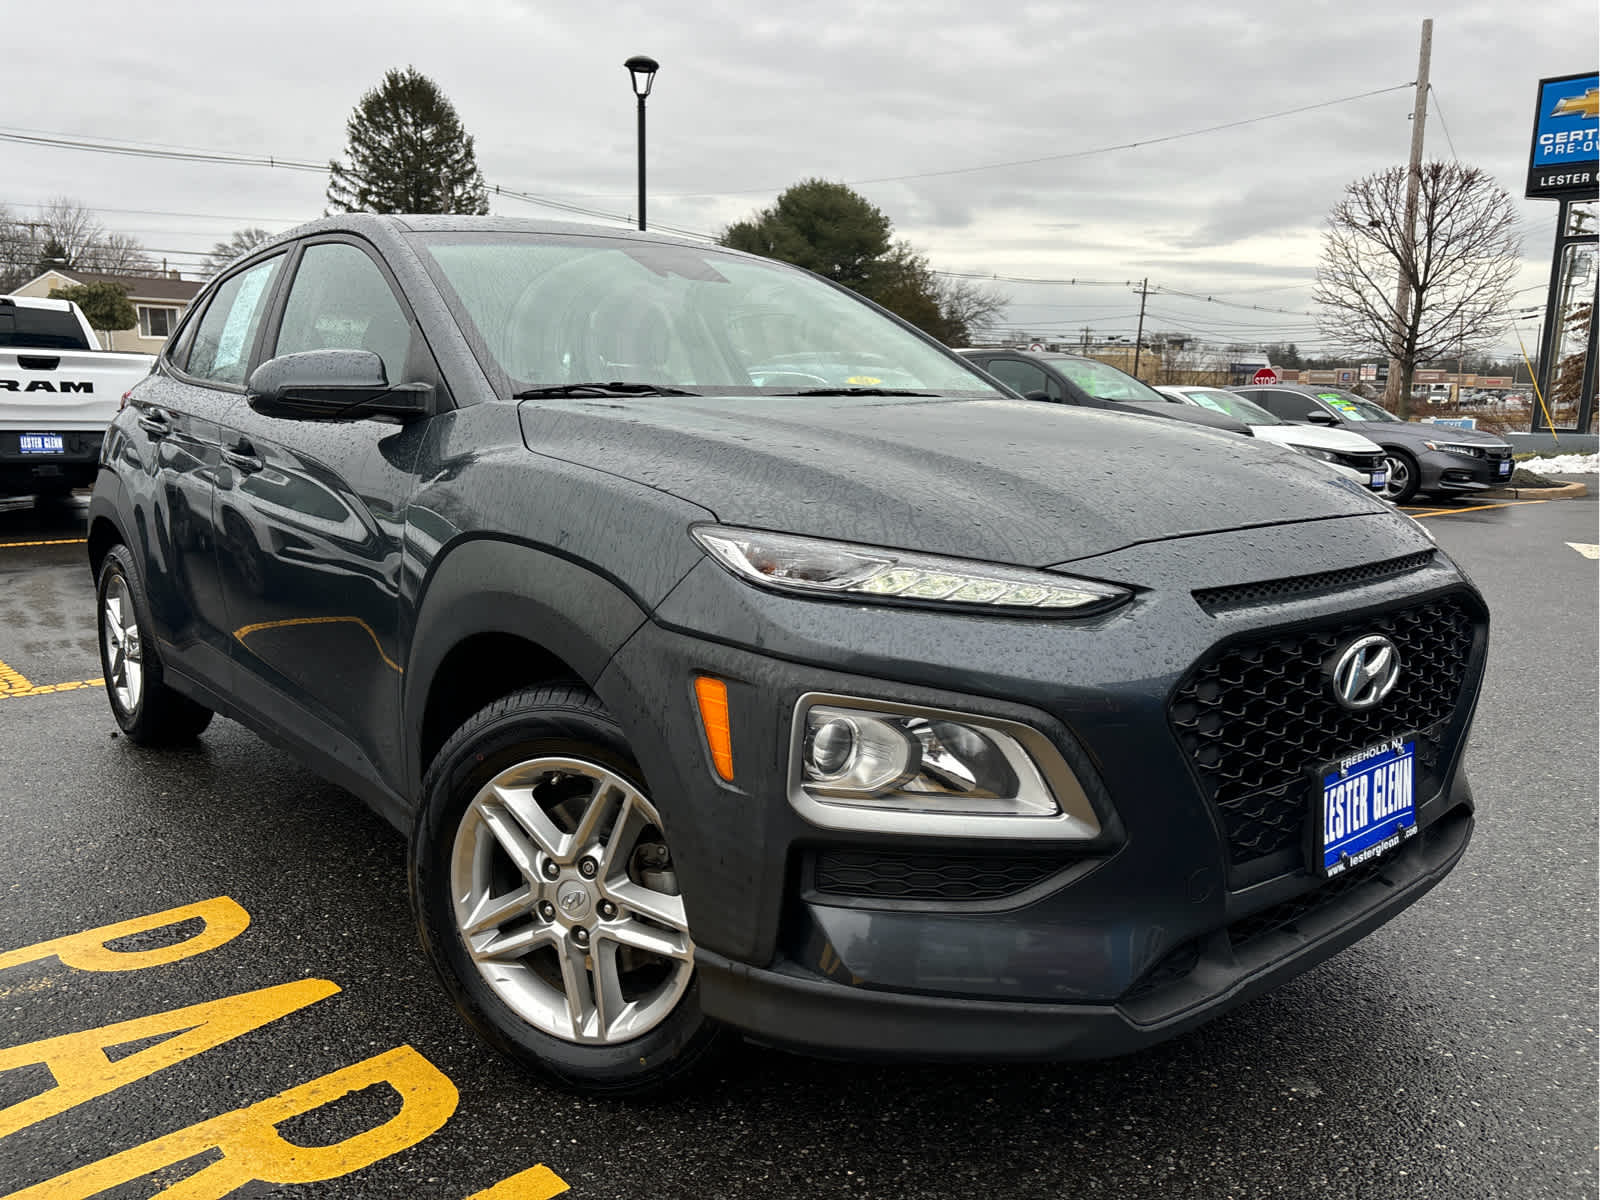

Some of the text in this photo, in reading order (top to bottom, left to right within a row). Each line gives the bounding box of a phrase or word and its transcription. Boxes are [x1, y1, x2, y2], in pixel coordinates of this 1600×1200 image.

[1540, 128, 1599, 145] CERT
[1541, 173, 1590, 186] LESTER
[0, 380, 94, 393] RAM
[1254, 376, 1276, 385] STOP
[1341, 744, 1389, 769] FREEHOLD,
[1324, 757, 1412, 845] LESTER GLENN
[1350, 836, 1400, 867] lesterglenn
[0, 896, 570, 1200] PAR
